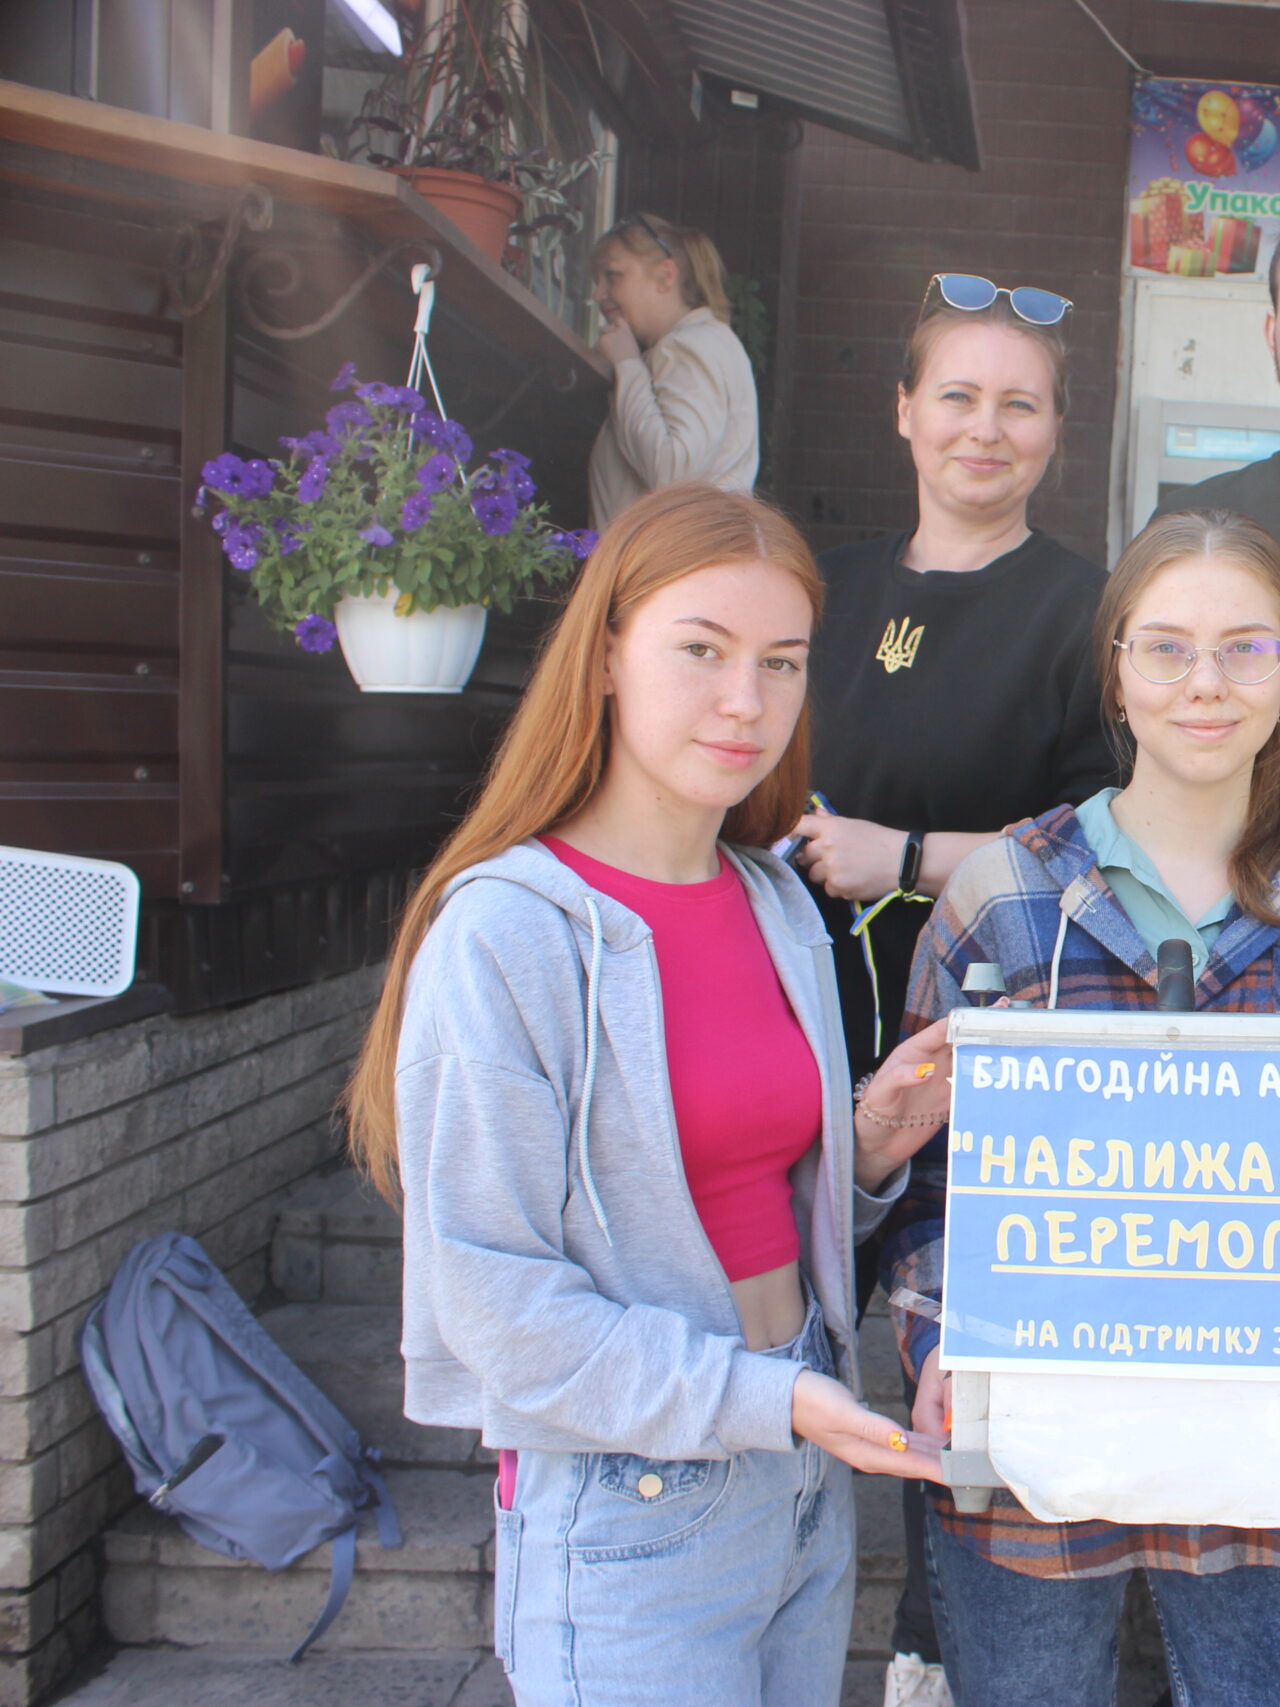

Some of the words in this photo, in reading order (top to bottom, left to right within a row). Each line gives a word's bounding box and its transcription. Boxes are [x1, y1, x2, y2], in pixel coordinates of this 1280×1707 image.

[972, 1052, 1240, 1102] БЛАГОДІЙНА
[1014, 1319, 1059, 1349] НА
[1073, 1321, 1261, 1356] ПІДТРИМКУ
